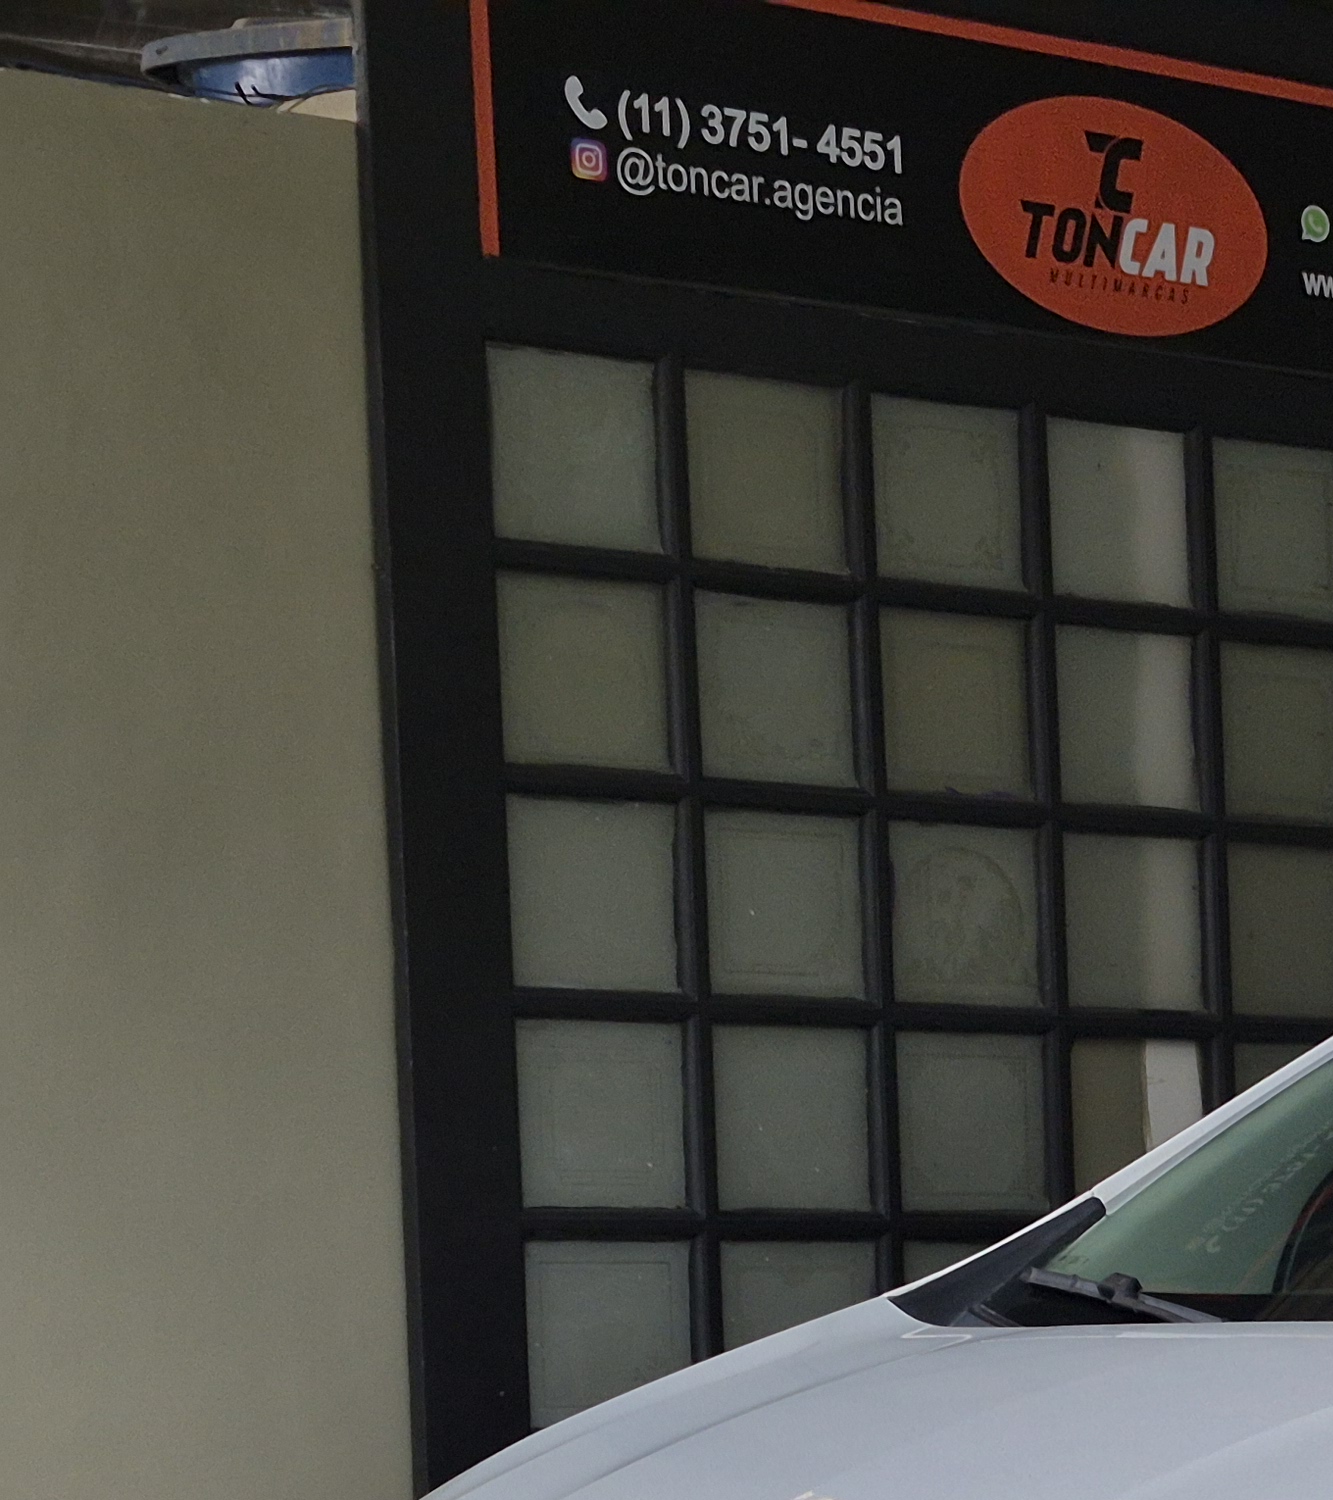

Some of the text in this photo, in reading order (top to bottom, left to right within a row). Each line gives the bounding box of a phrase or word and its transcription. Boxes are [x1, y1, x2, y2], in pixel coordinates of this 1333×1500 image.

[617, 89, 903, 175] (11) 3751- 4551
[616, 146, 904, 227] @toncar.agencia
[1021, 200, 1214, 286] TONCAR
[1051, 268, 1189, 304] MULTIMARCAS
